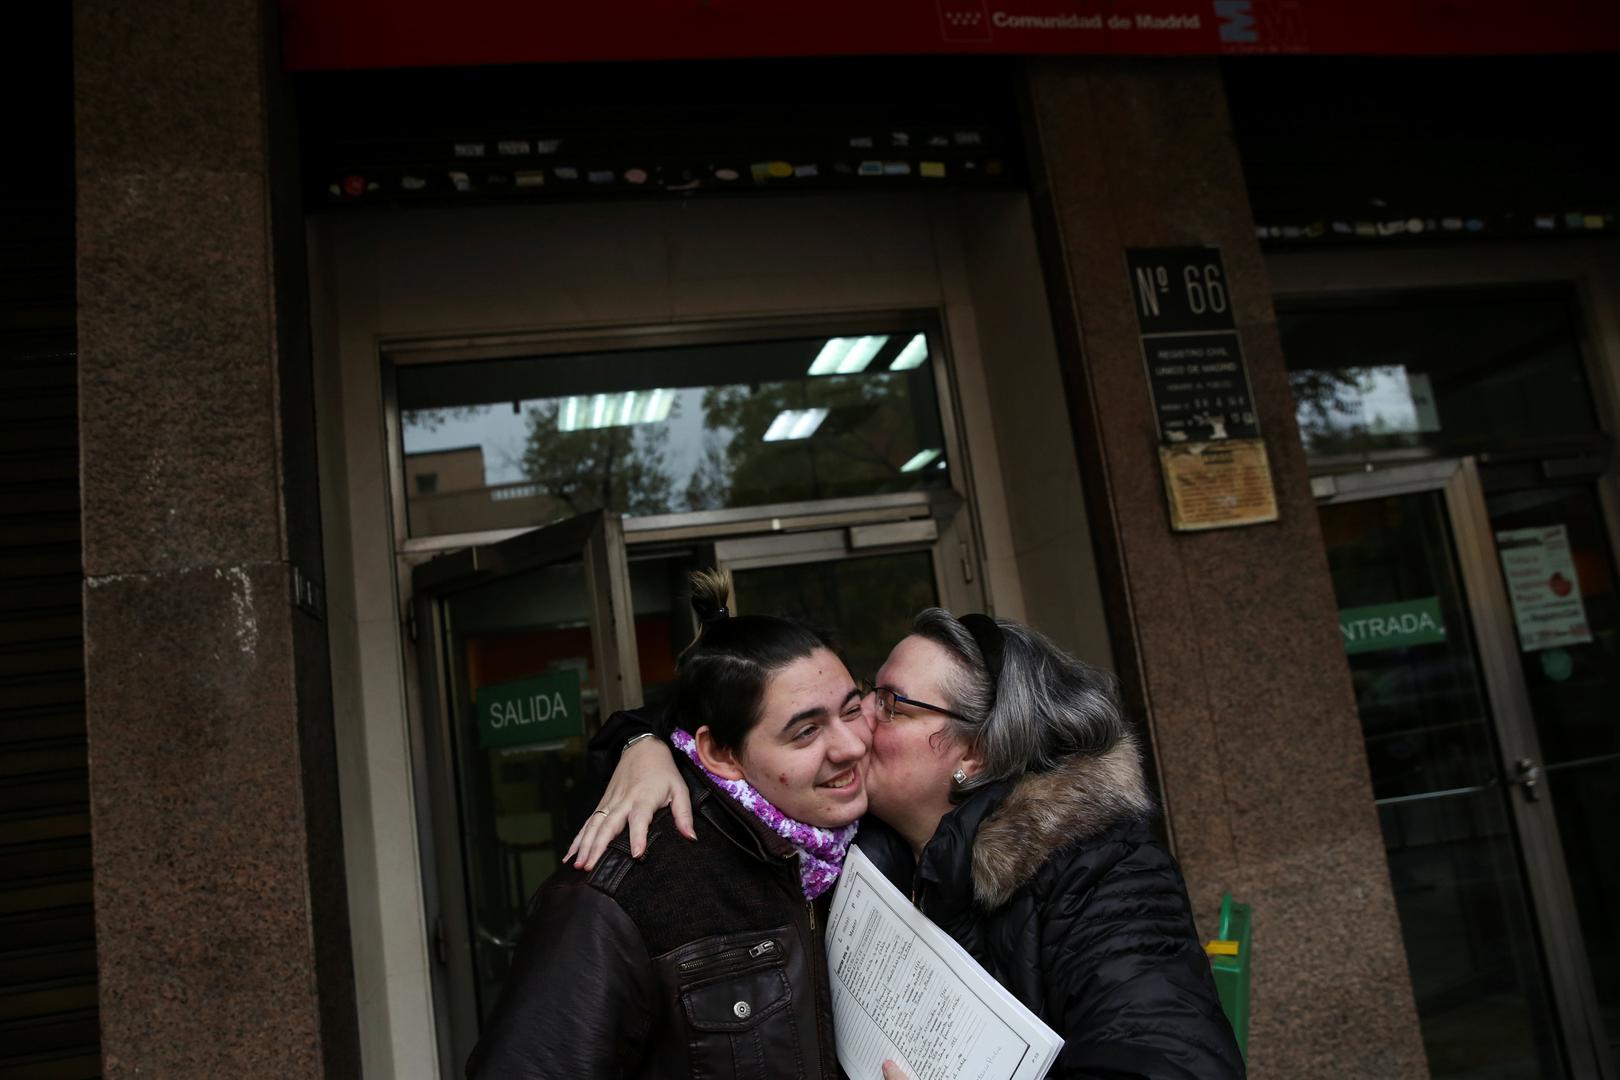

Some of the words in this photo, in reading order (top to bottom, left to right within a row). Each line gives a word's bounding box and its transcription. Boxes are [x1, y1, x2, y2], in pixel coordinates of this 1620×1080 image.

[992, 11, 1104, 30] Comunidad
[1108, 13, 1132, 30] de
[1135, 13, 1201, 30] Madrid
[1136, 265, 1169, 316] Nº
[1184, 263, 1226, 315] 66
[1339, 611, 1436, 641] NTRADA
[490, 691, 568, 729] SALIDA
